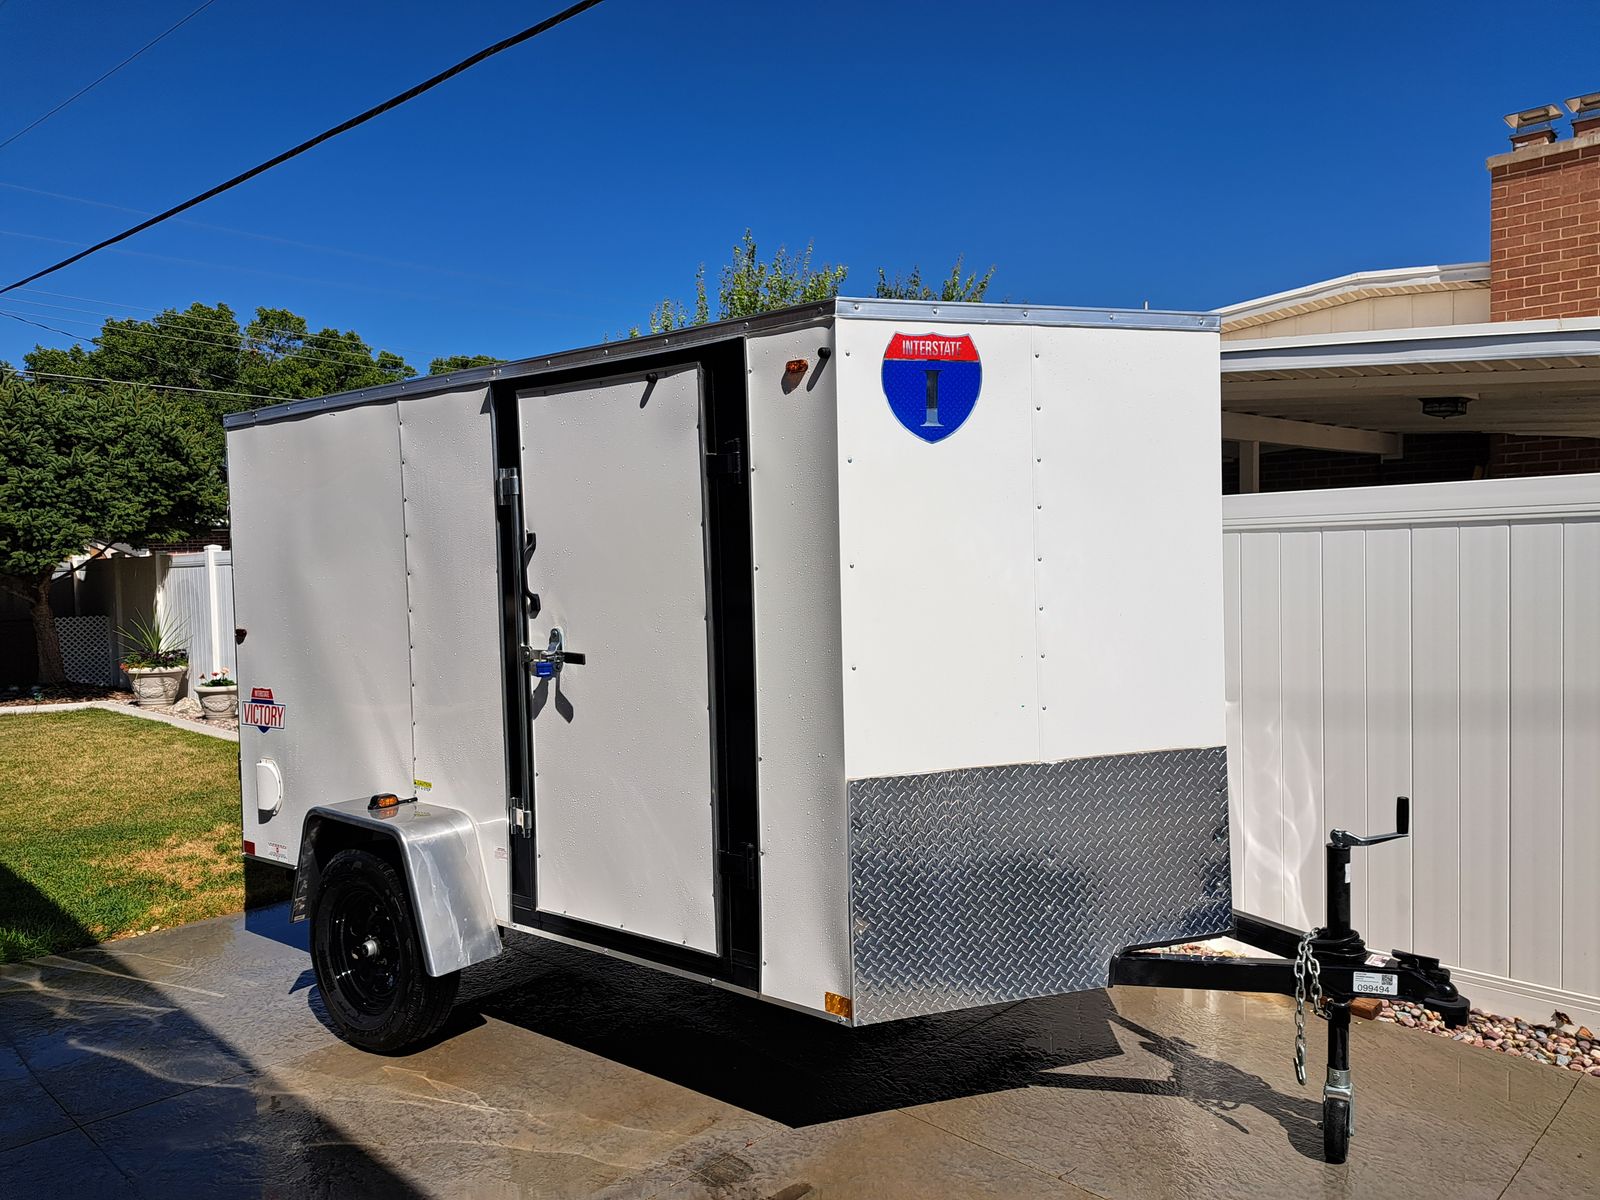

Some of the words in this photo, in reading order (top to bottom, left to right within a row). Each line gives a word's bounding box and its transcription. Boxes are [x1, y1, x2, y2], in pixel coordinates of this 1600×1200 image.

[902, 339, 962, 357] INTERSTATE
[920, 369, 945, 427] I
[243, 703, 284, 727] VICTORY
[1357, 983, 1390, 994] 099494
